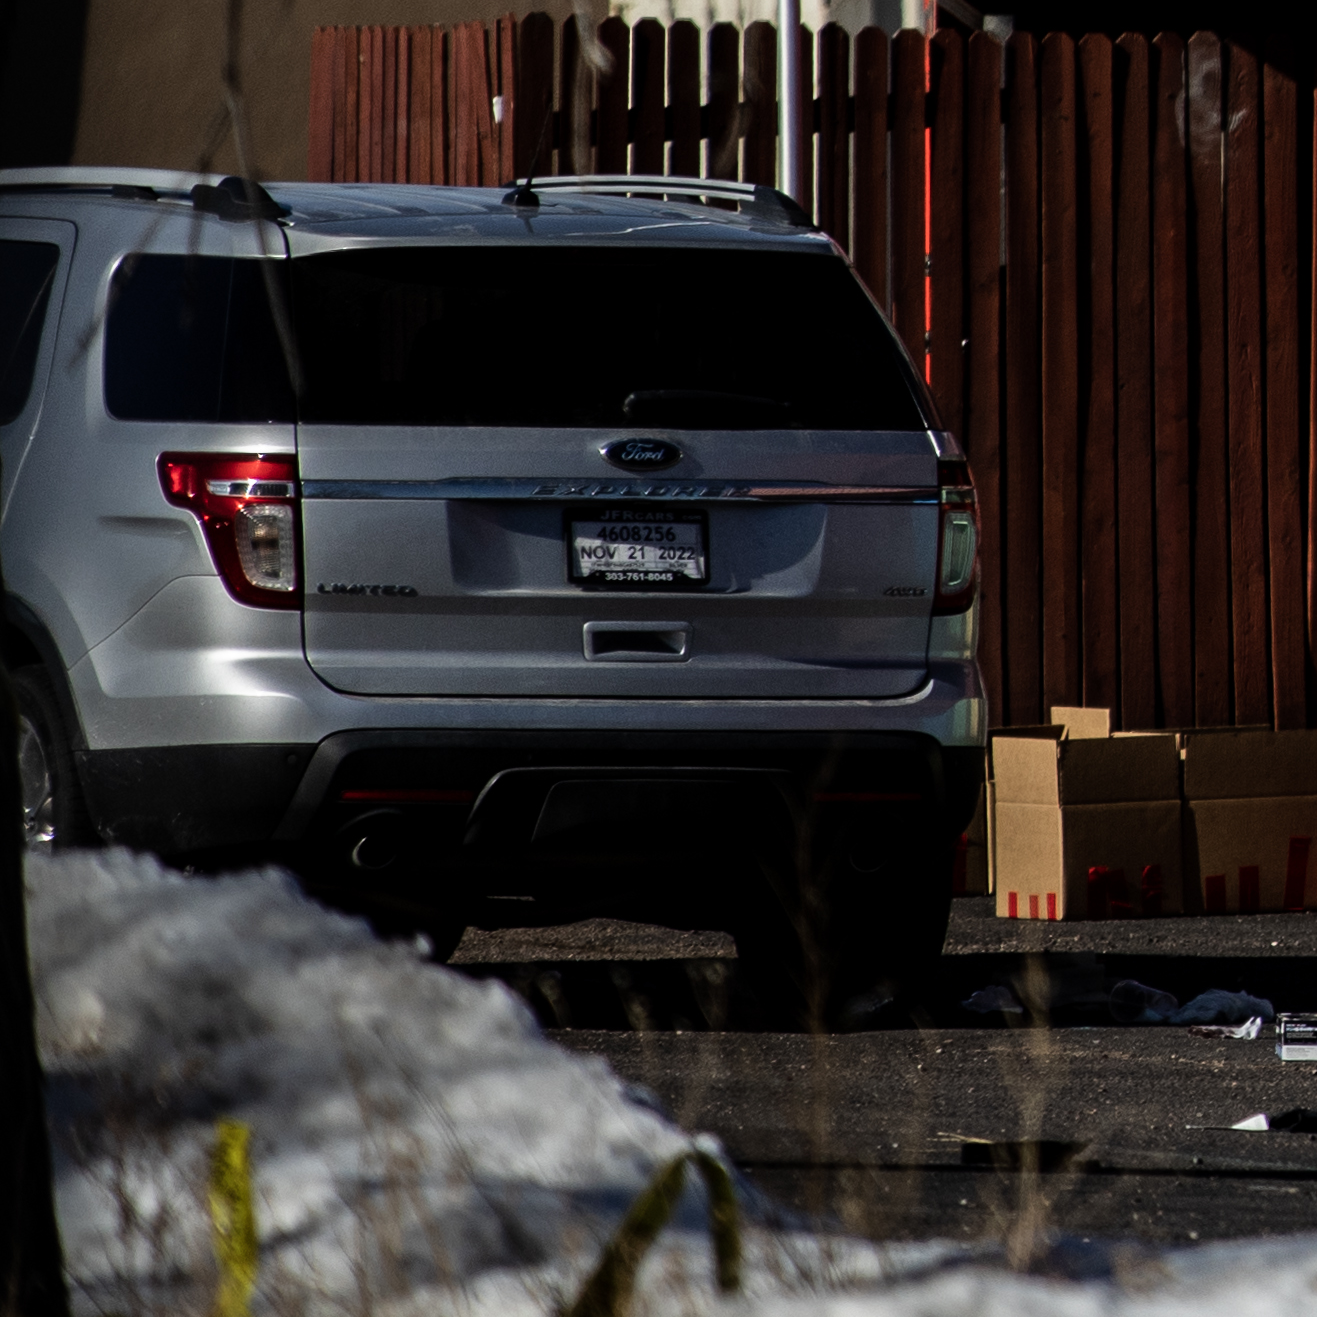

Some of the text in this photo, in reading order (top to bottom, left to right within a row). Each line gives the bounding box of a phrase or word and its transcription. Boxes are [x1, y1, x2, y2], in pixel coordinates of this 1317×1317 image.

[620, 442, 665, 462] Ford
[531, 485, 750, 497] EXPLORER
[597, 526, 676, 542] 4608256
[581, 546, 696, 561] NOV 21 2022
[605, 572, 674, 581] 303-761-8045
[317, 582, 419, 597] LIMITED
